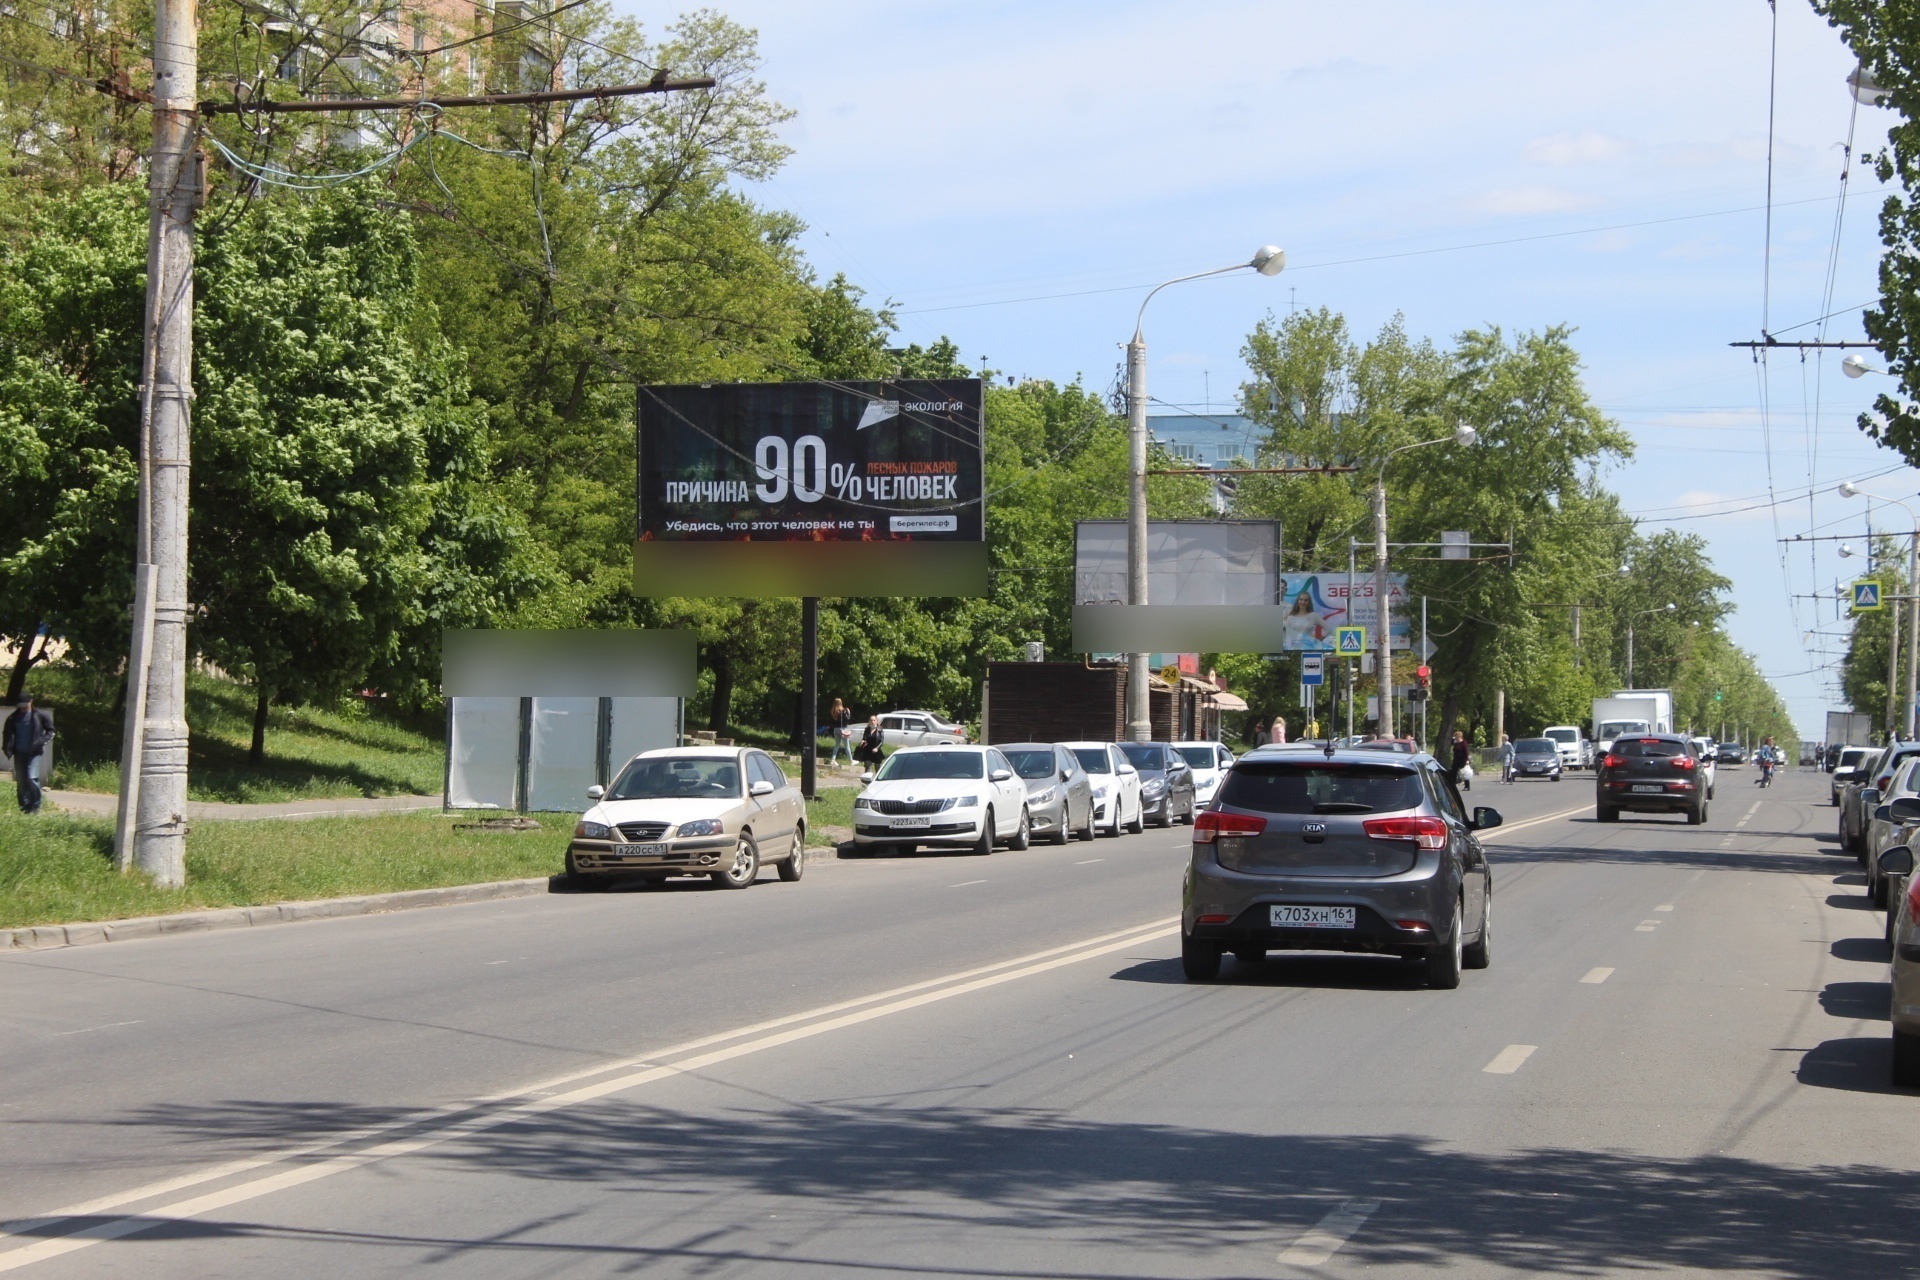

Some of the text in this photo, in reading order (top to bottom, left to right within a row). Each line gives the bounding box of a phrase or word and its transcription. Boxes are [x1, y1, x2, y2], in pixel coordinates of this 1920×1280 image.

[867, 461, 957, 474] ЛЕСНЫХ ПОЖАРОВ
[666, 481, 749, 503] ПРИЧИНА
[866, 475, 957, 500] ЧЕЛОВЕК
[666, 520, 875, 532] Убедись, что этот человек не ты
[897, 520, 950, 528] берегилес.рф
[1164, 669, 1176, 678] 24
